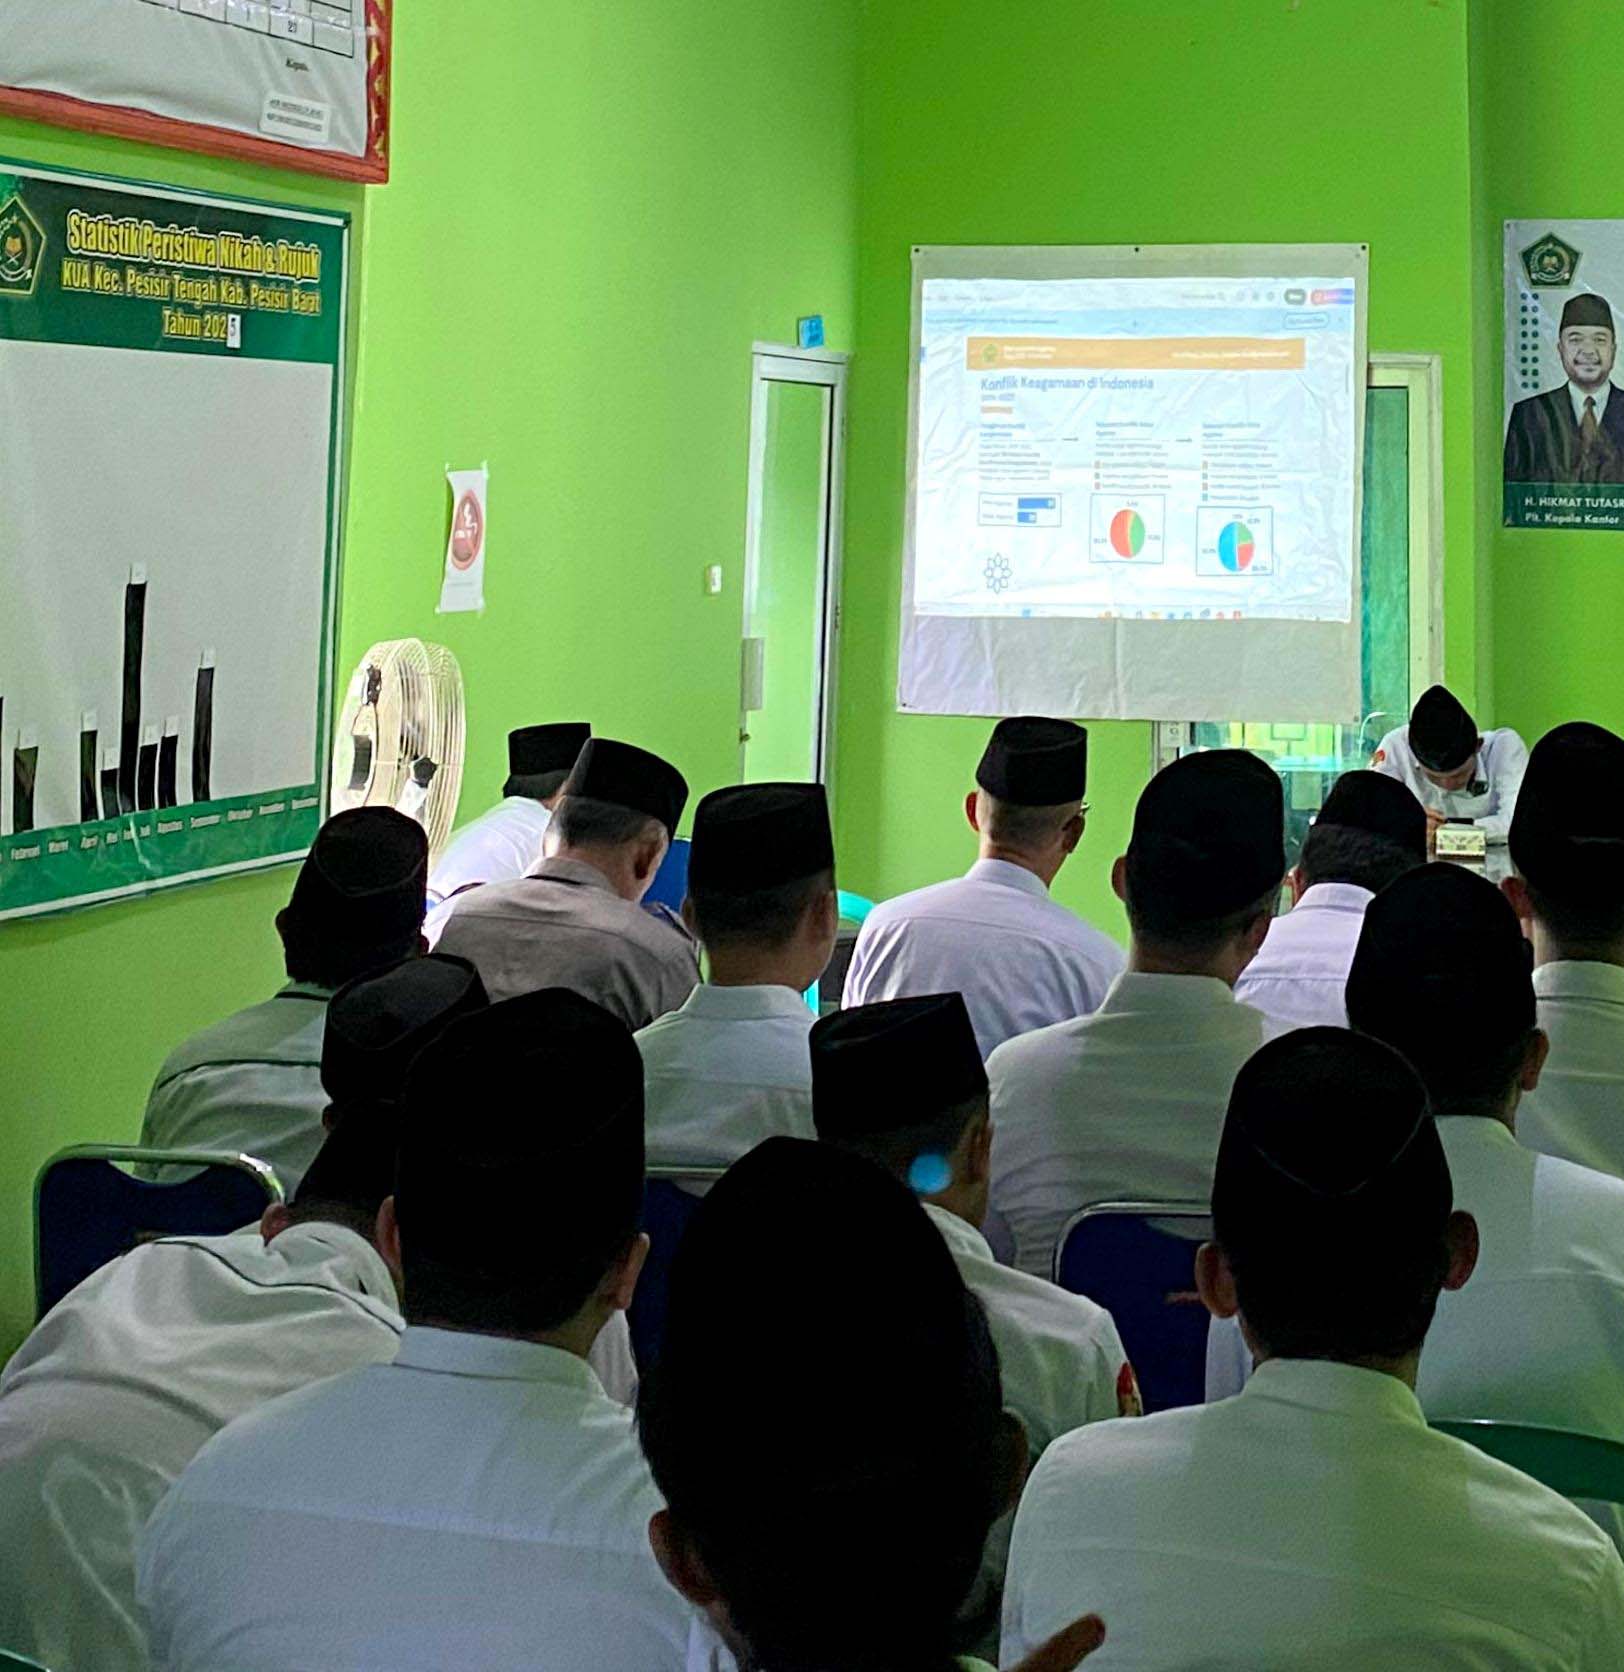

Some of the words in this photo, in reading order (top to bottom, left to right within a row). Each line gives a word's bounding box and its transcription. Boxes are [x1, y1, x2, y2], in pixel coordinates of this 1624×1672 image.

[68, 209, 143, 260] Statistik
[142, 220, 218, 268] Peristiwa
[218, 231, 263, 274] Nikah
[262, 243, 276, 275] &
[276, 239, 322, 283] Rujuk
[62, 258, 91, 290] KUA
[93, 260, 123, 295] Kec.
[126, 266, 171, 300] Pesisir
[173, 272, 218, 308] Tengah
[219, 278, 248, 308] Kab.
[249, 281, 290, 313] Pesisir
[291, 288, 322, 316] Barat
[163, 307, 201, 339] Tahun
[1100, 377, 1155, 390] Indonesia
[1525, 497, 1536, 506] H.
[1539, 497, 1582, 508] HIKMAT
[1544, 513, 1582, 525] Kepala
[1584, 514, 1620, 524] Kantor
